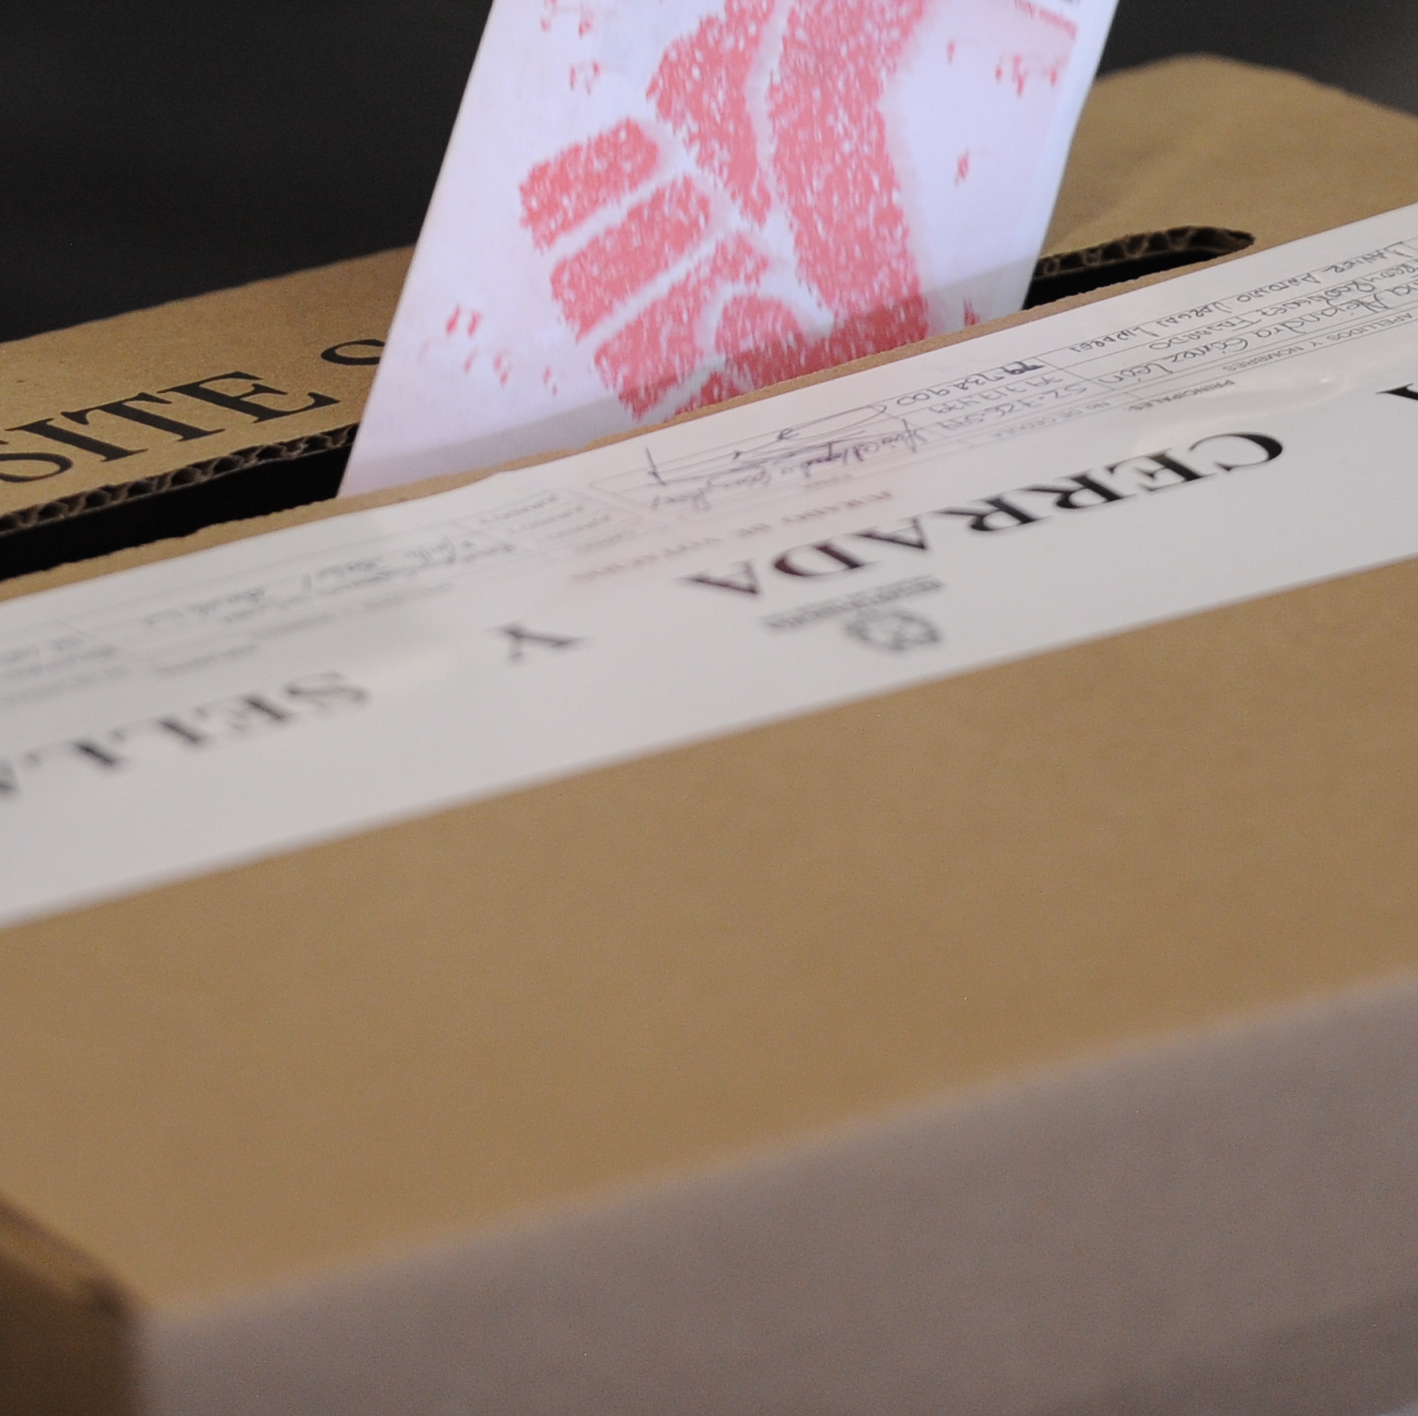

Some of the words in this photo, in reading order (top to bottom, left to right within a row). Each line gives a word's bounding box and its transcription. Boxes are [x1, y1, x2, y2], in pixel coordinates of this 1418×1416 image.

[1326, 312, 1413, 342] APELLIDOS
[1222, 345, 1304, 372] NOMBRES
[1310, 340, 1324, 348] Y
[683, 431, 1285, 598] CERRADA
[496, 623, 586, 665] Y
